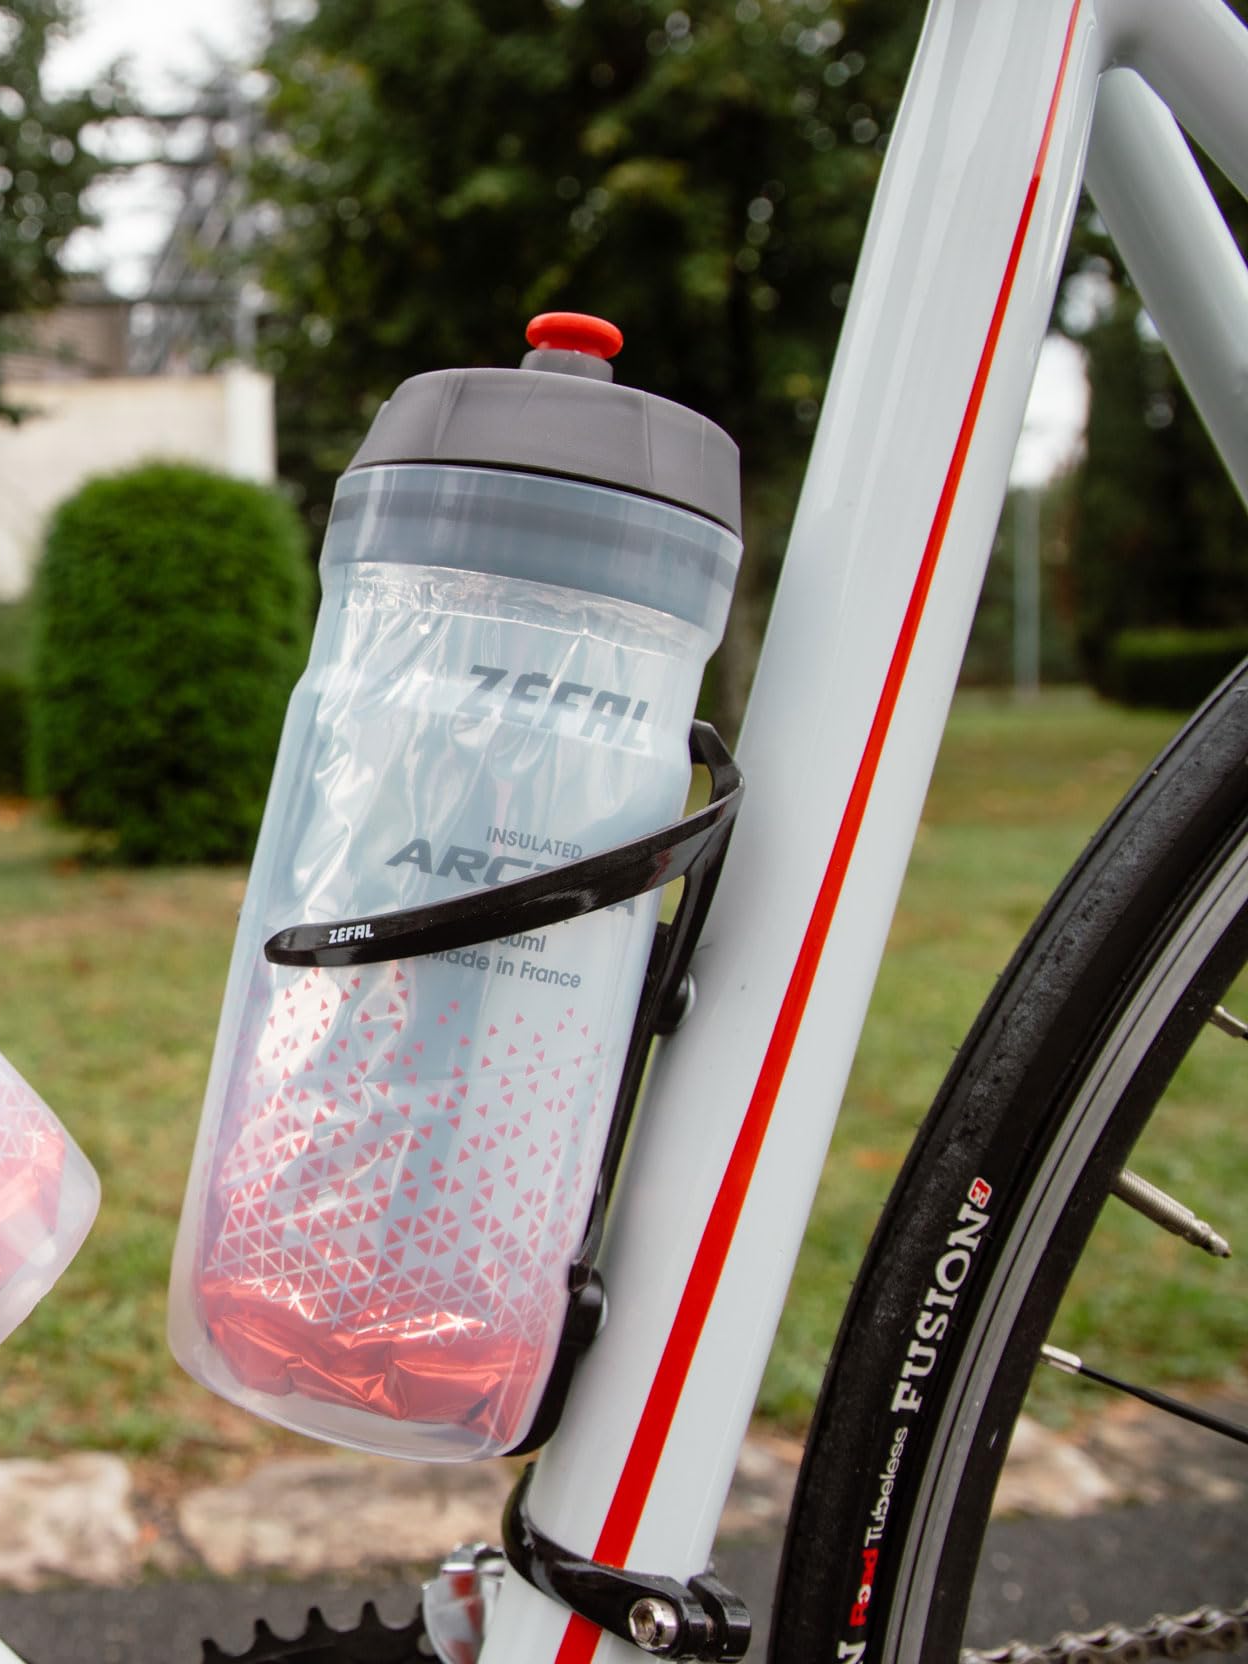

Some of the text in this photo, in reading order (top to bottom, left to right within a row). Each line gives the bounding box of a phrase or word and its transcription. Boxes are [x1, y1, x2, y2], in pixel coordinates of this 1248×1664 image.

[486, 825, 582, 859] INSULATED
[496, 956, 514, 976] in
[519, 960, 582, 988] France
[849, 1548, 879, 1627] Road
[864, 1426, 909, 1548] Tubeless
